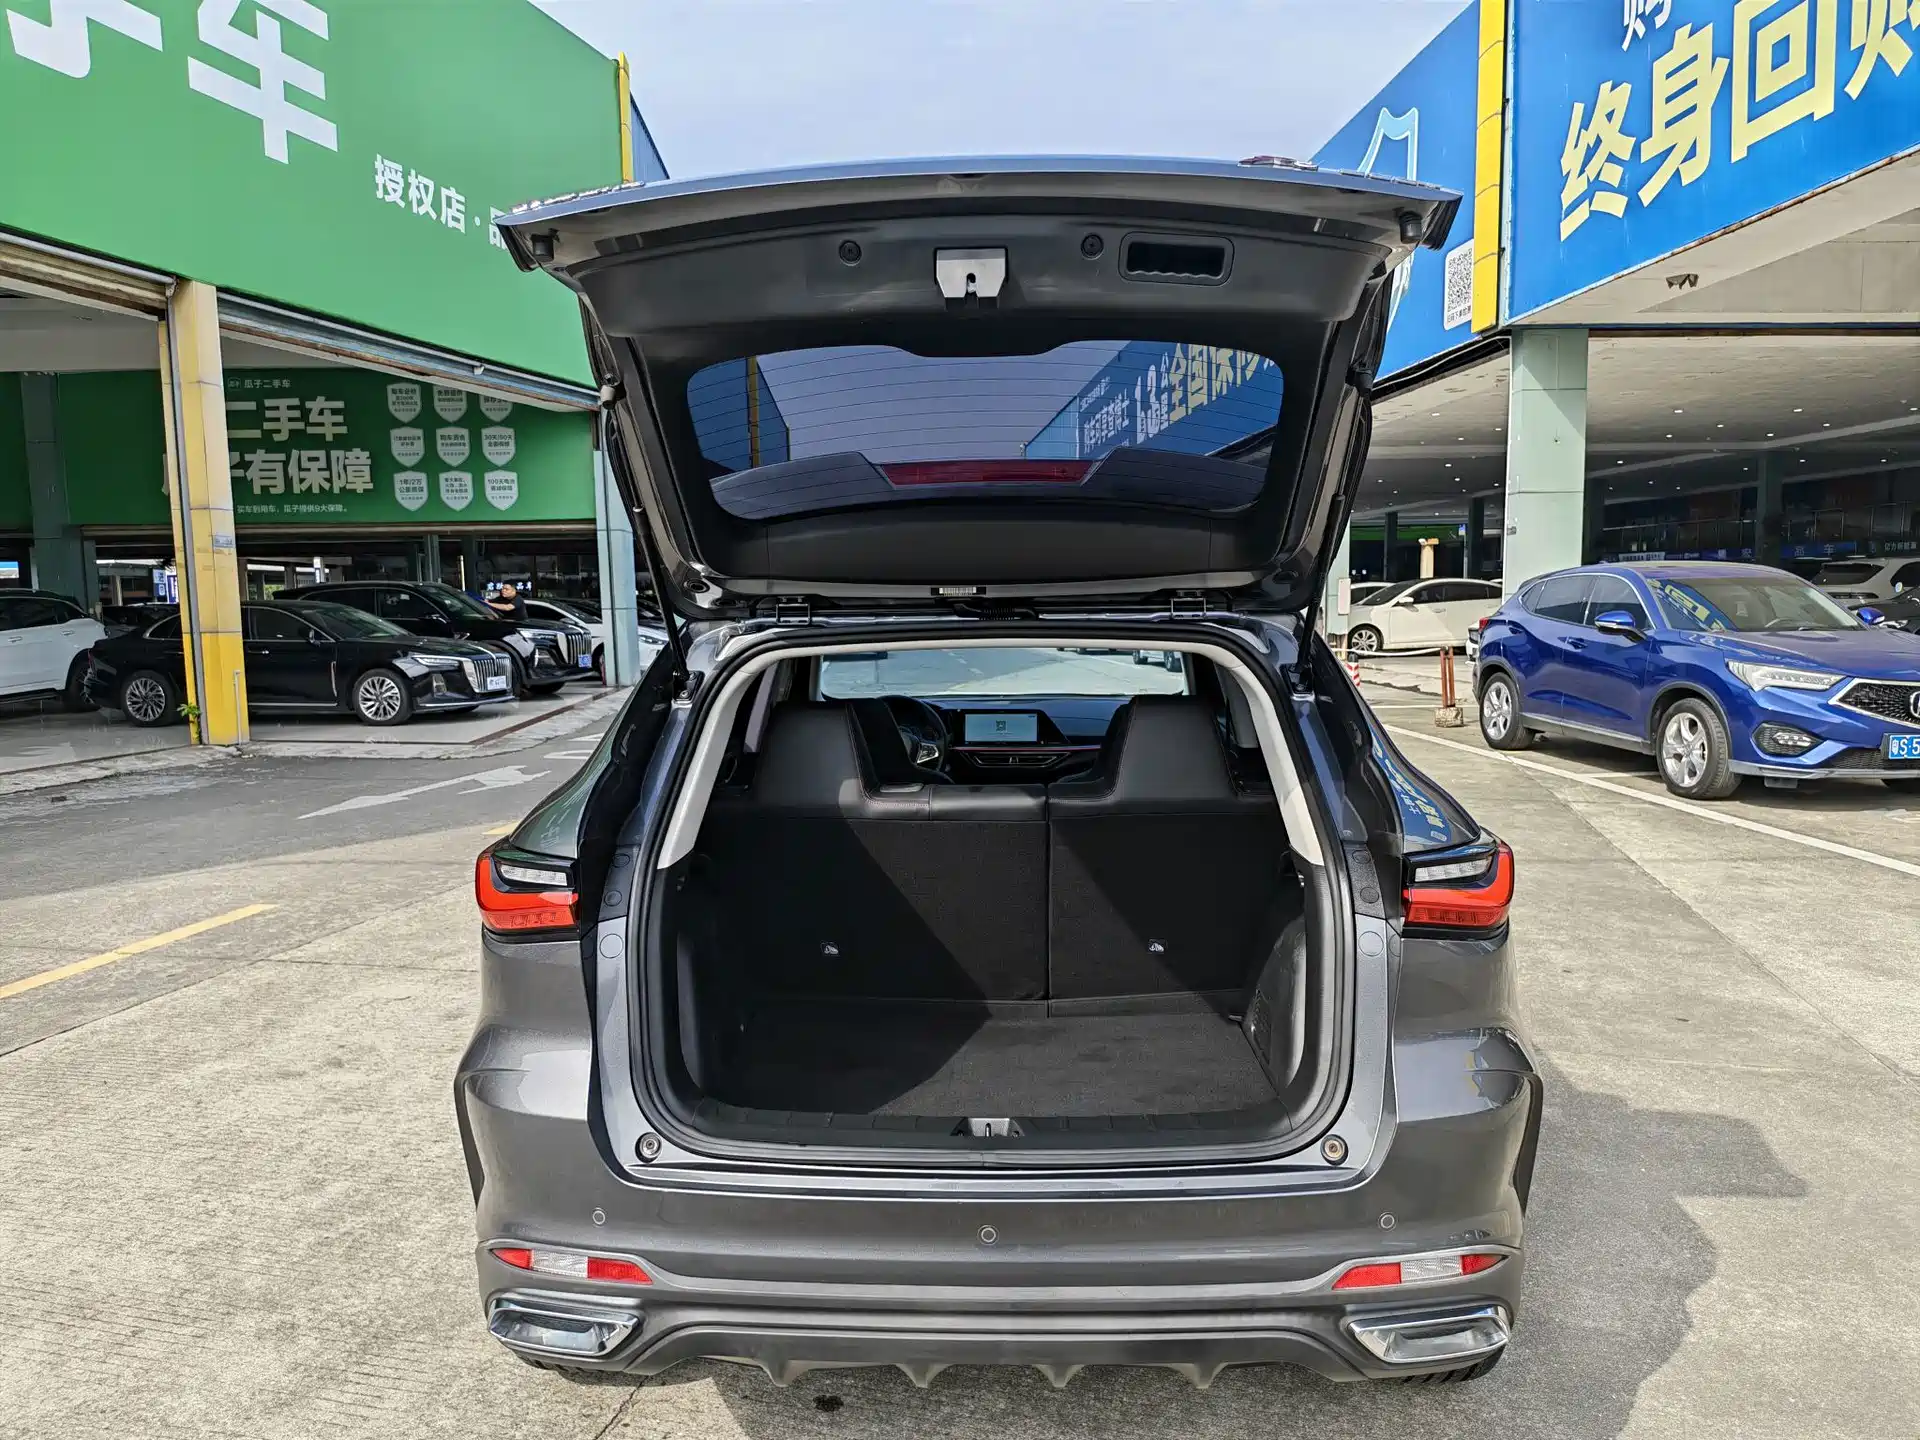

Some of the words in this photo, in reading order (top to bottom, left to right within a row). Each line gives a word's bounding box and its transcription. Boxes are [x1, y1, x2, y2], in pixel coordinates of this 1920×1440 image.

[244, 379, 291, 389] 瓜子二手车
[162, 448, 374, 495] 有保障
